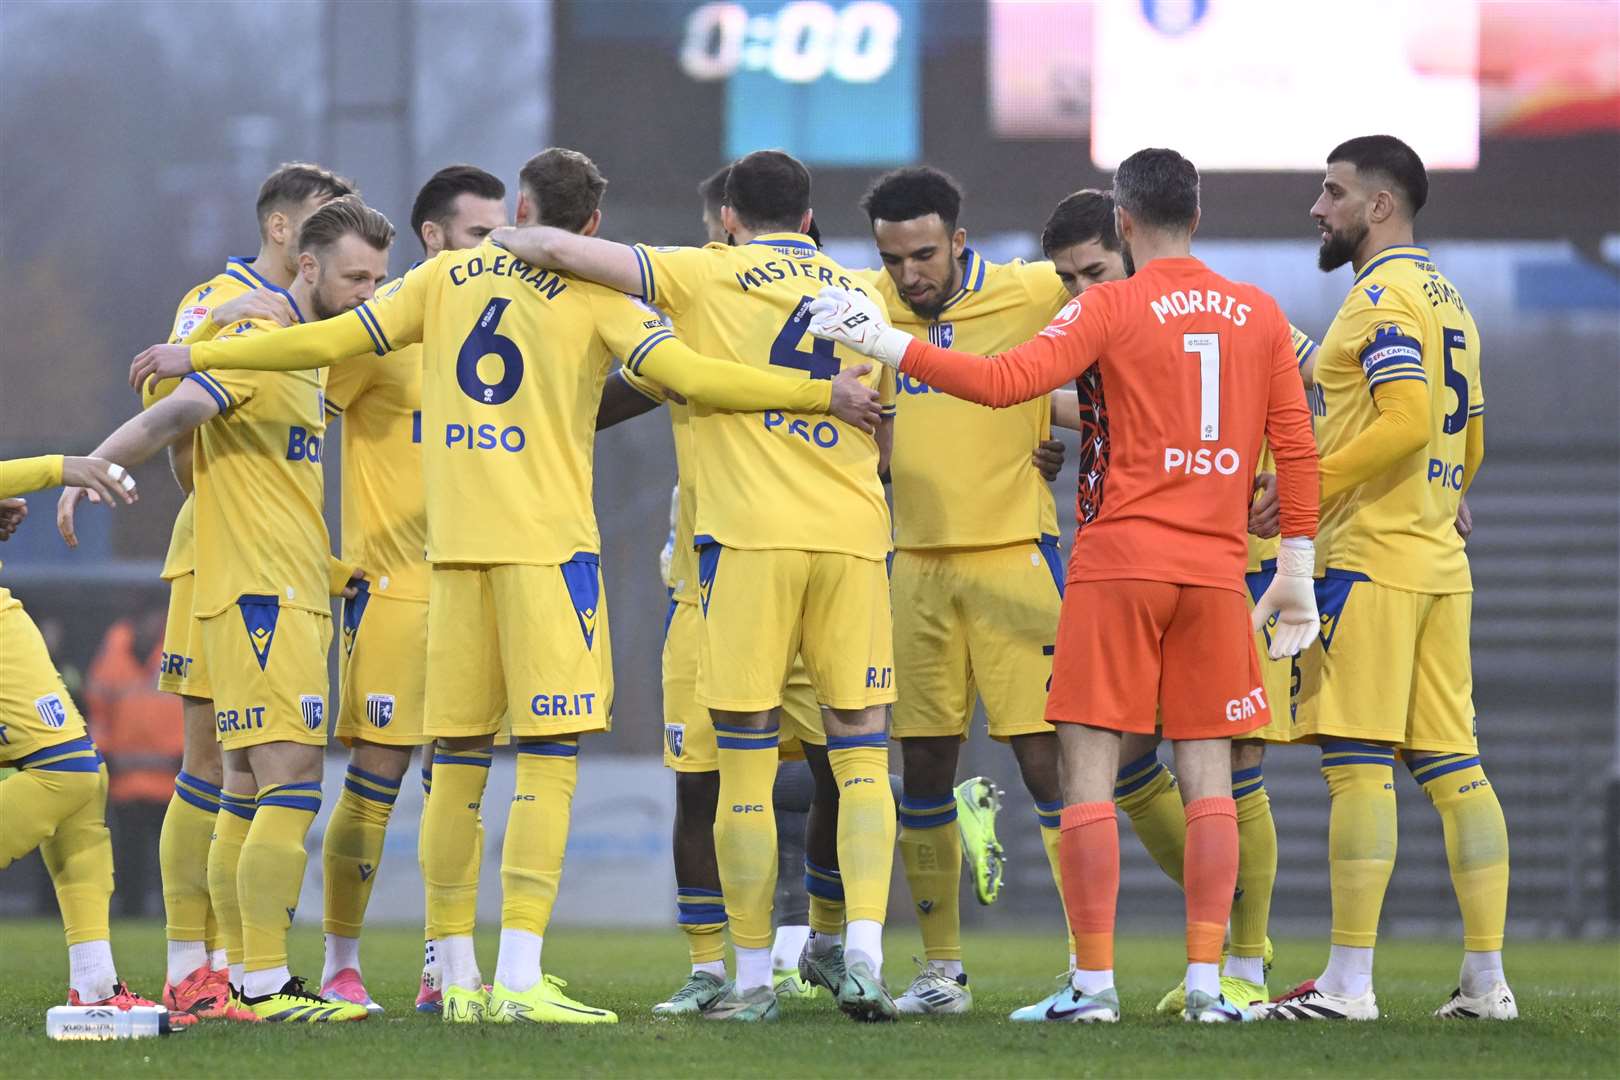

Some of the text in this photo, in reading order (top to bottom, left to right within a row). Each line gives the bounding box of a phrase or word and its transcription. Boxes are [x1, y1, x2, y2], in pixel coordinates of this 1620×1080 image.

[681, 1, 901, 83] 0:00
[449, 255, 567, 300] COEMAN
[735, 259, 868, 292] MASTERS
[1150, 289, 1252, 327] MORRIS
[456, 297, 525, 405] 6
[769, 295, 842, 380] 4
[1183, 333, 1220, 441] 1
[1443, 326, 1469, 435] 5
[445, 424, 526, 452] PISO
[1164, 447, 1240, 475] PISO
[1428, 458, 1464, 491] PIO
[216, 706, 266, 732] GR.IT
[531, 693, 596, 716] GR.IT
[732, 803, 765, 814] GFC
